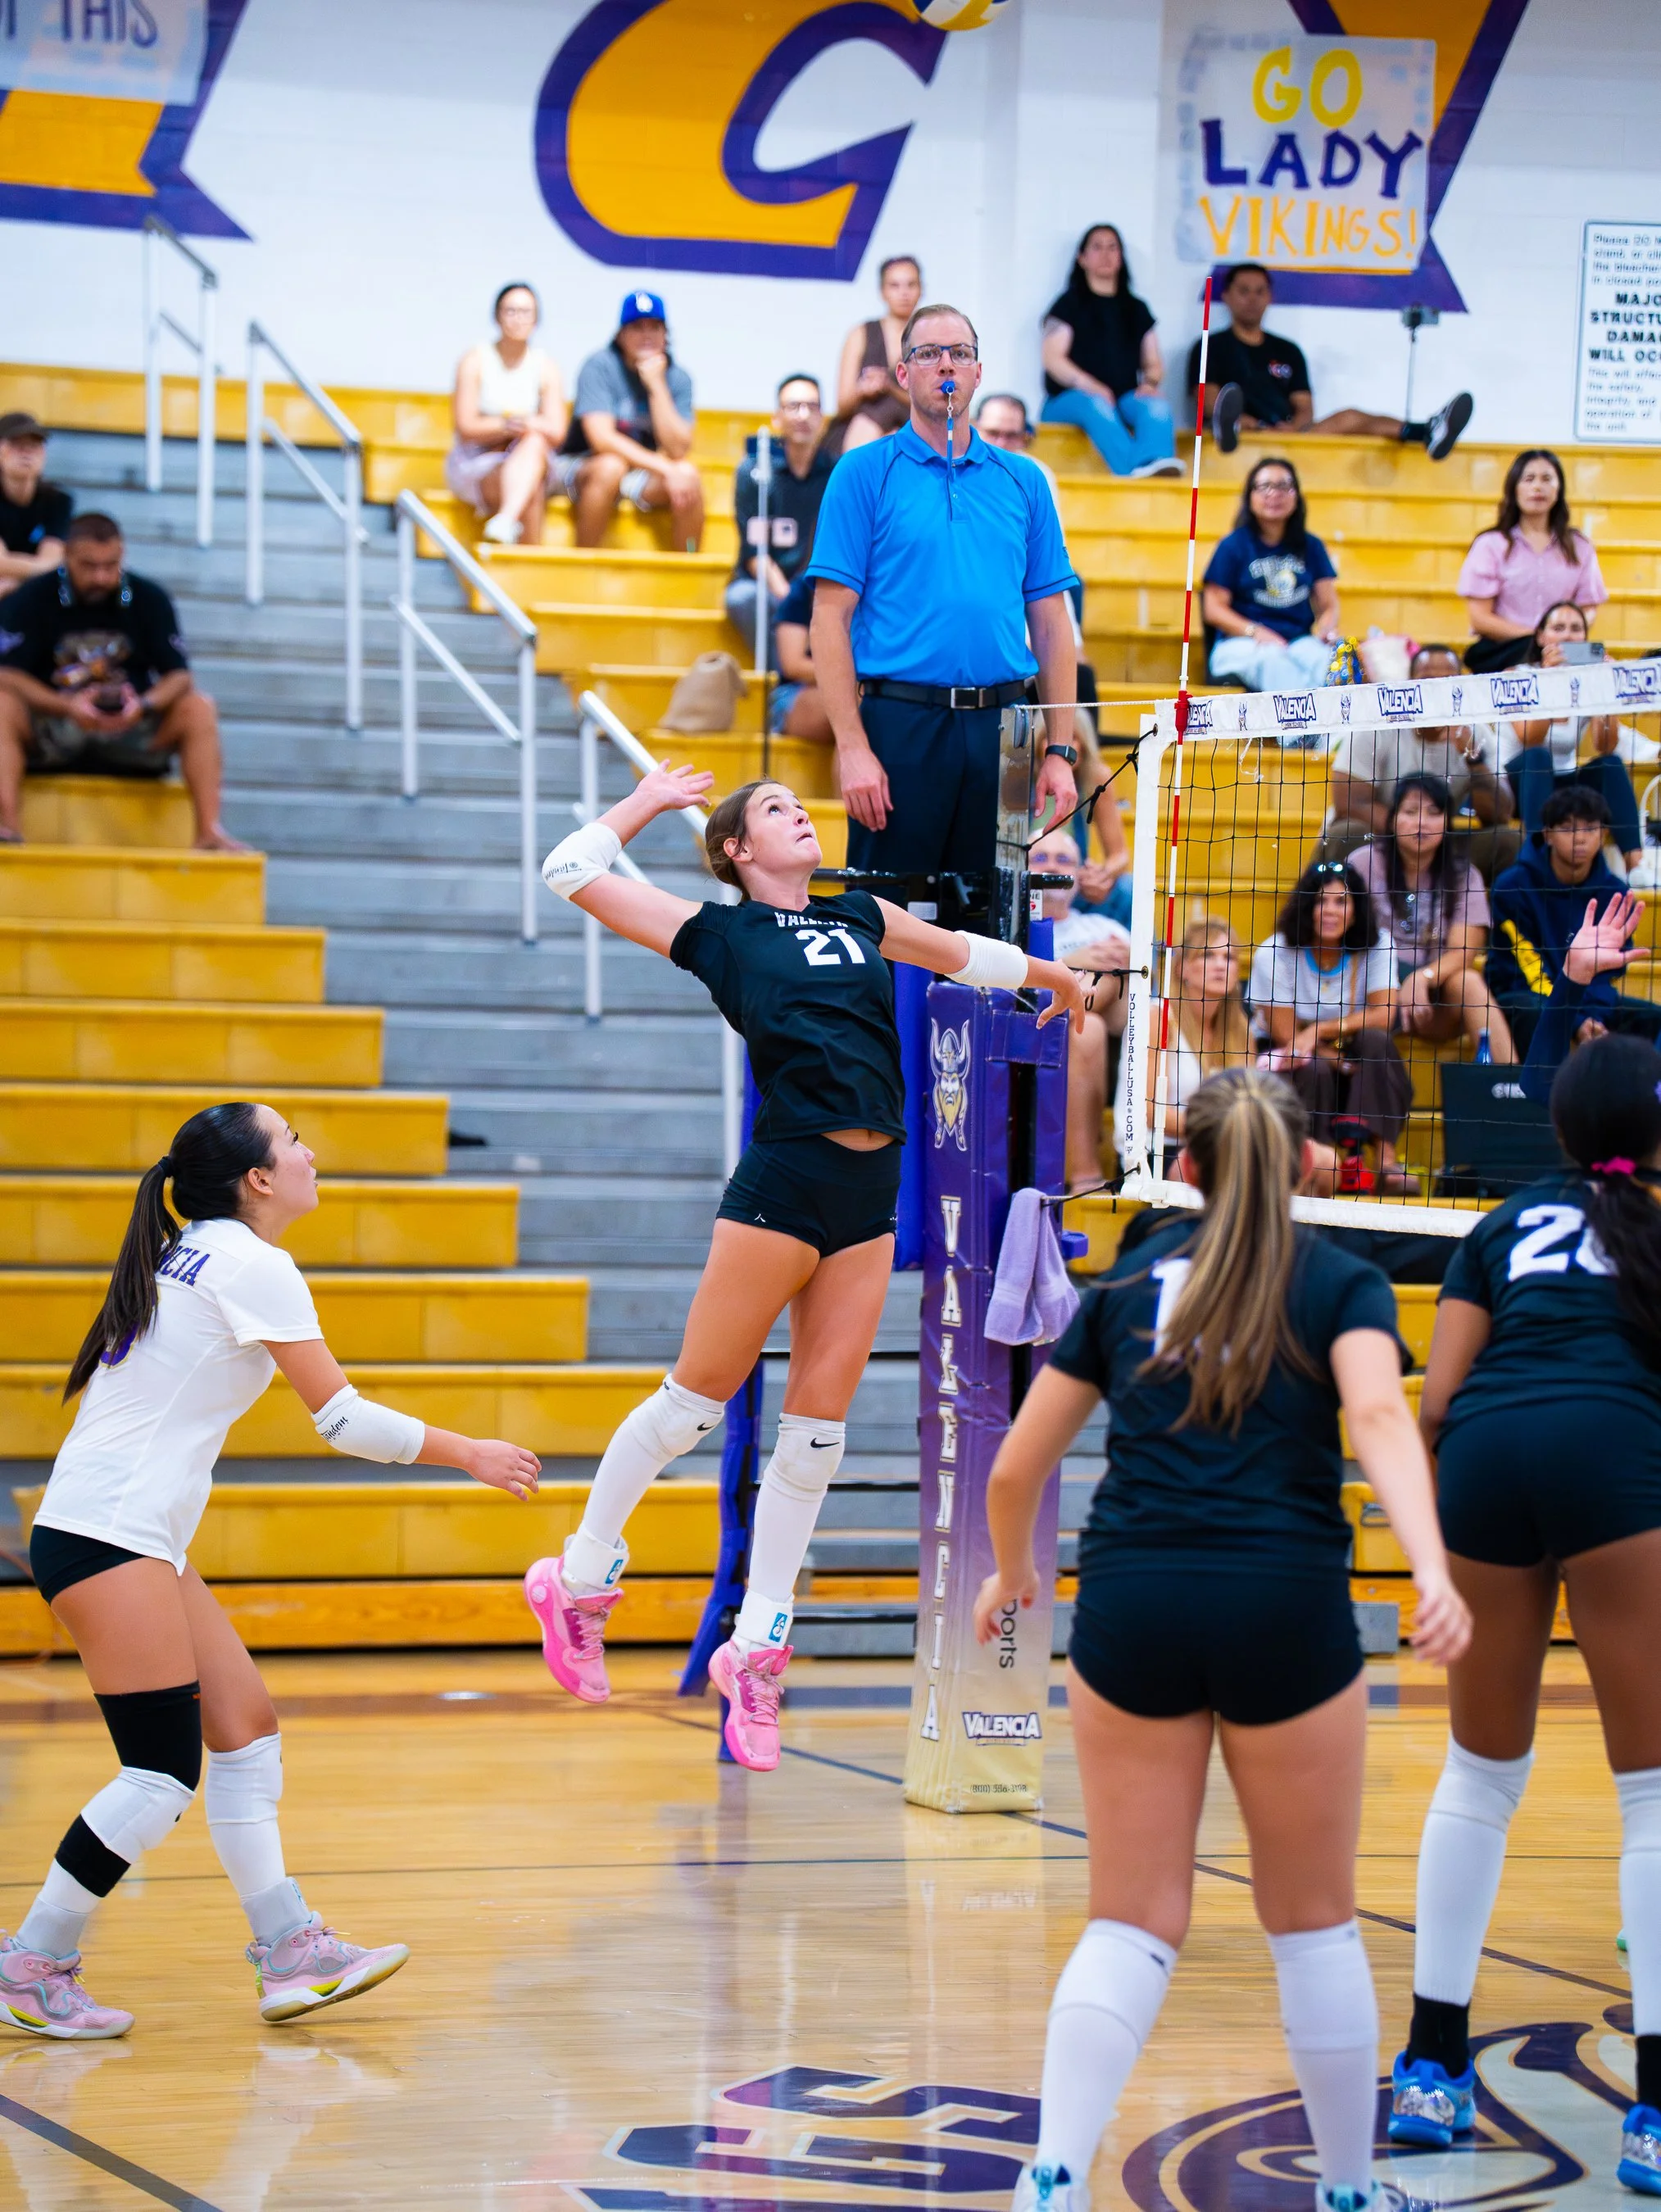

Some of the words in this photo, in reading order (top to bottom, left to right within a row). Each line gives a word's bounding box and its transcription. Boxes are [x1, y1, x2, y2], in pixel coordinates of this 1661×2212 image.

[1252, 46, 1363, 129] GO
[1200, 118, 1423, 200] LADY
[1198, 194, 1417, 260] VIKINGS!
[1590, 349, 1625, 361] WILL
[1608, 330, 1661, 342] DAMA
[795, 928, 865, 966] 21
[920, 1195, 961, 1742] VALENCIA
[999, 1599, 1018, 1669] ports
[961, 1711, 1042, 1739] VALENCIA
